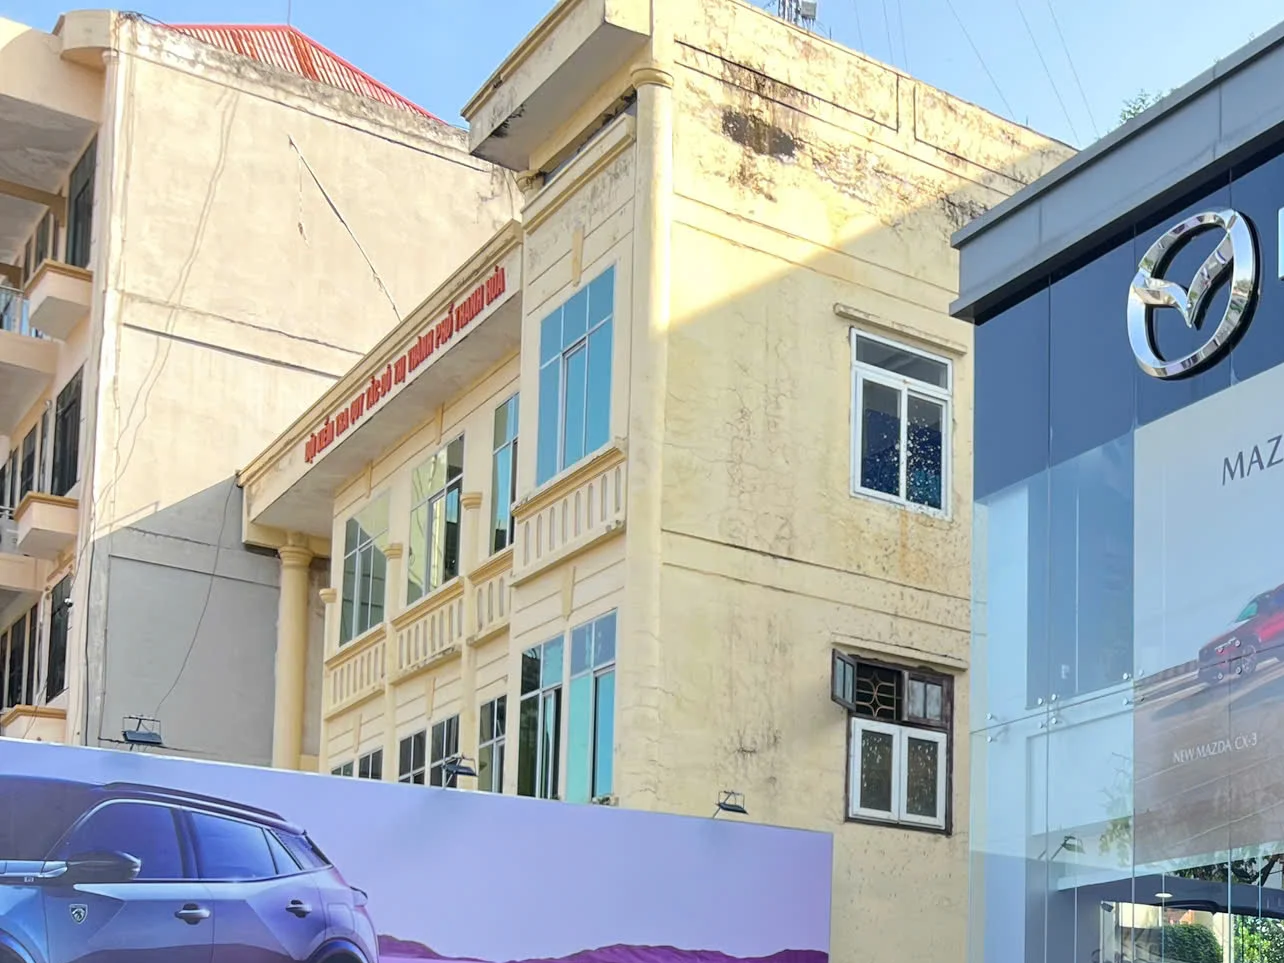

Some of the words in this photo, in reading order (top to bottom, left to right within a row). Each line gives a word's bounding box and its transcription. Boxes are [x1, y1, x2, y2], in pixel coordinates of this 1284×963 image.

[454, 284, 485, 333] THANH
[1172, 749, 1195, 764] NEW
[1194, 739, 1233, 761] MAZDA
[1234, 731, 1258, 751] CX-3
